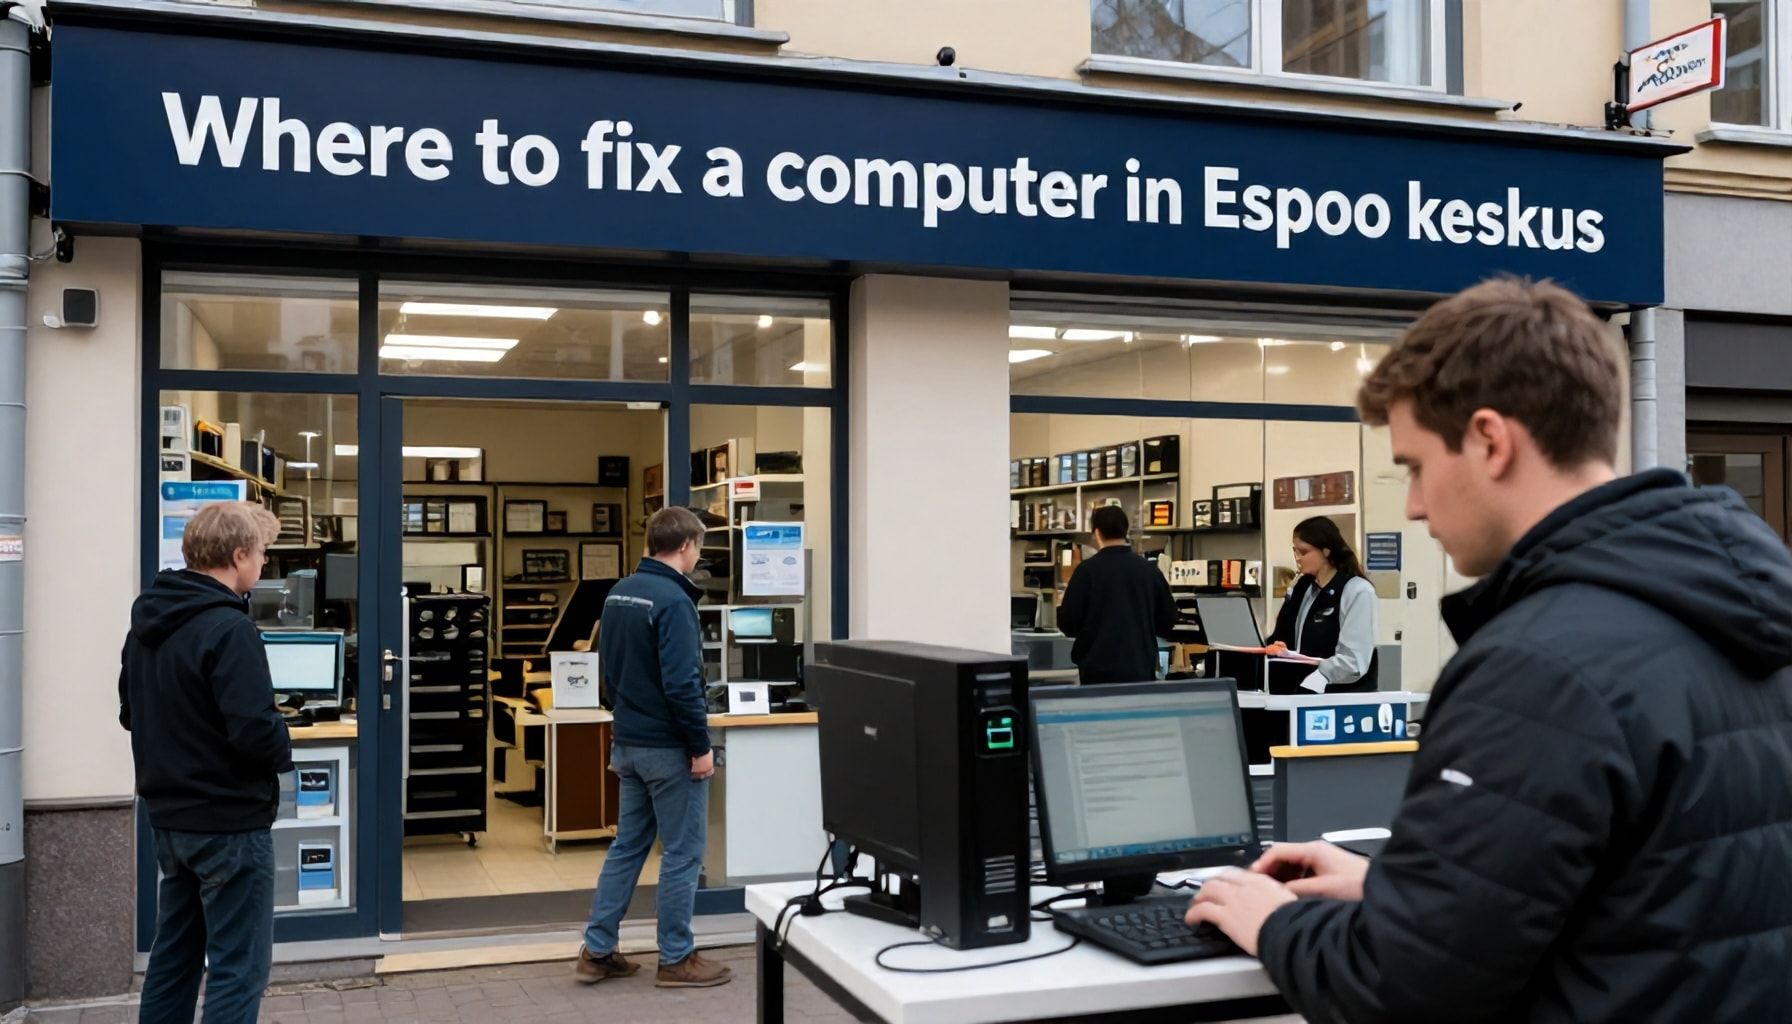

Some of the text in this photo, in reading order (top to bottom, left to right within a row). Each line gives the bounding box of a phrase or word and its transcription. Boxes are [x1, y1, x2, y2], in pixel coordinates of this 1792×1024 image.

[162, 92, 1605, 254] Where to fix a computer in Espoo keskus
